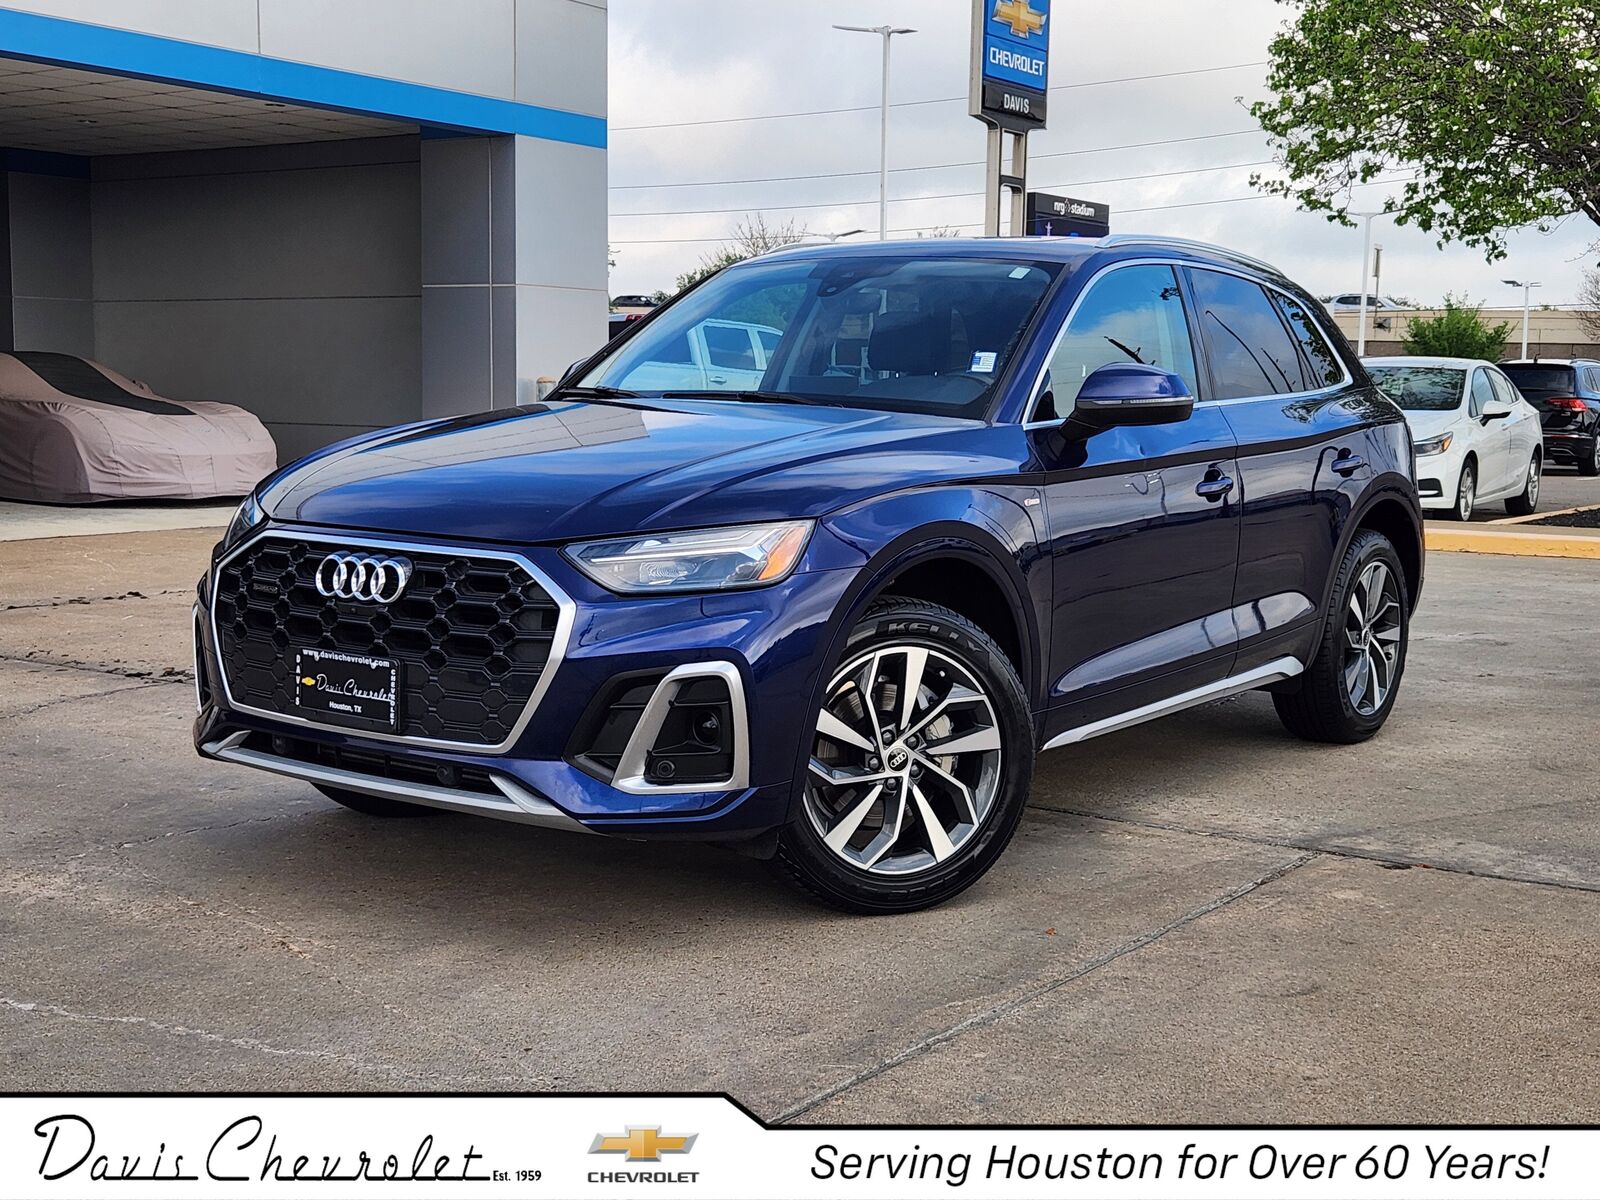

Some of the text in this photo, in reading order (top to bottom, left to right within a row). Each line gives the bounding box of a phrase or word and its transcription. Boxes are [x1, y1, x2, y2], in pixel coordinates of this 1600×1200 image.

[989, 46, 1045, 77] CHEVROLET
[1003, 93, 1030, 114] DAVIS
[1070, 202, 1095, 217] stadium
[302, 648, 390, 668] www.davischevrolet.com
[316, 673, 344, 694] Davis
[328, 700, 363, 713] Houston, TX
